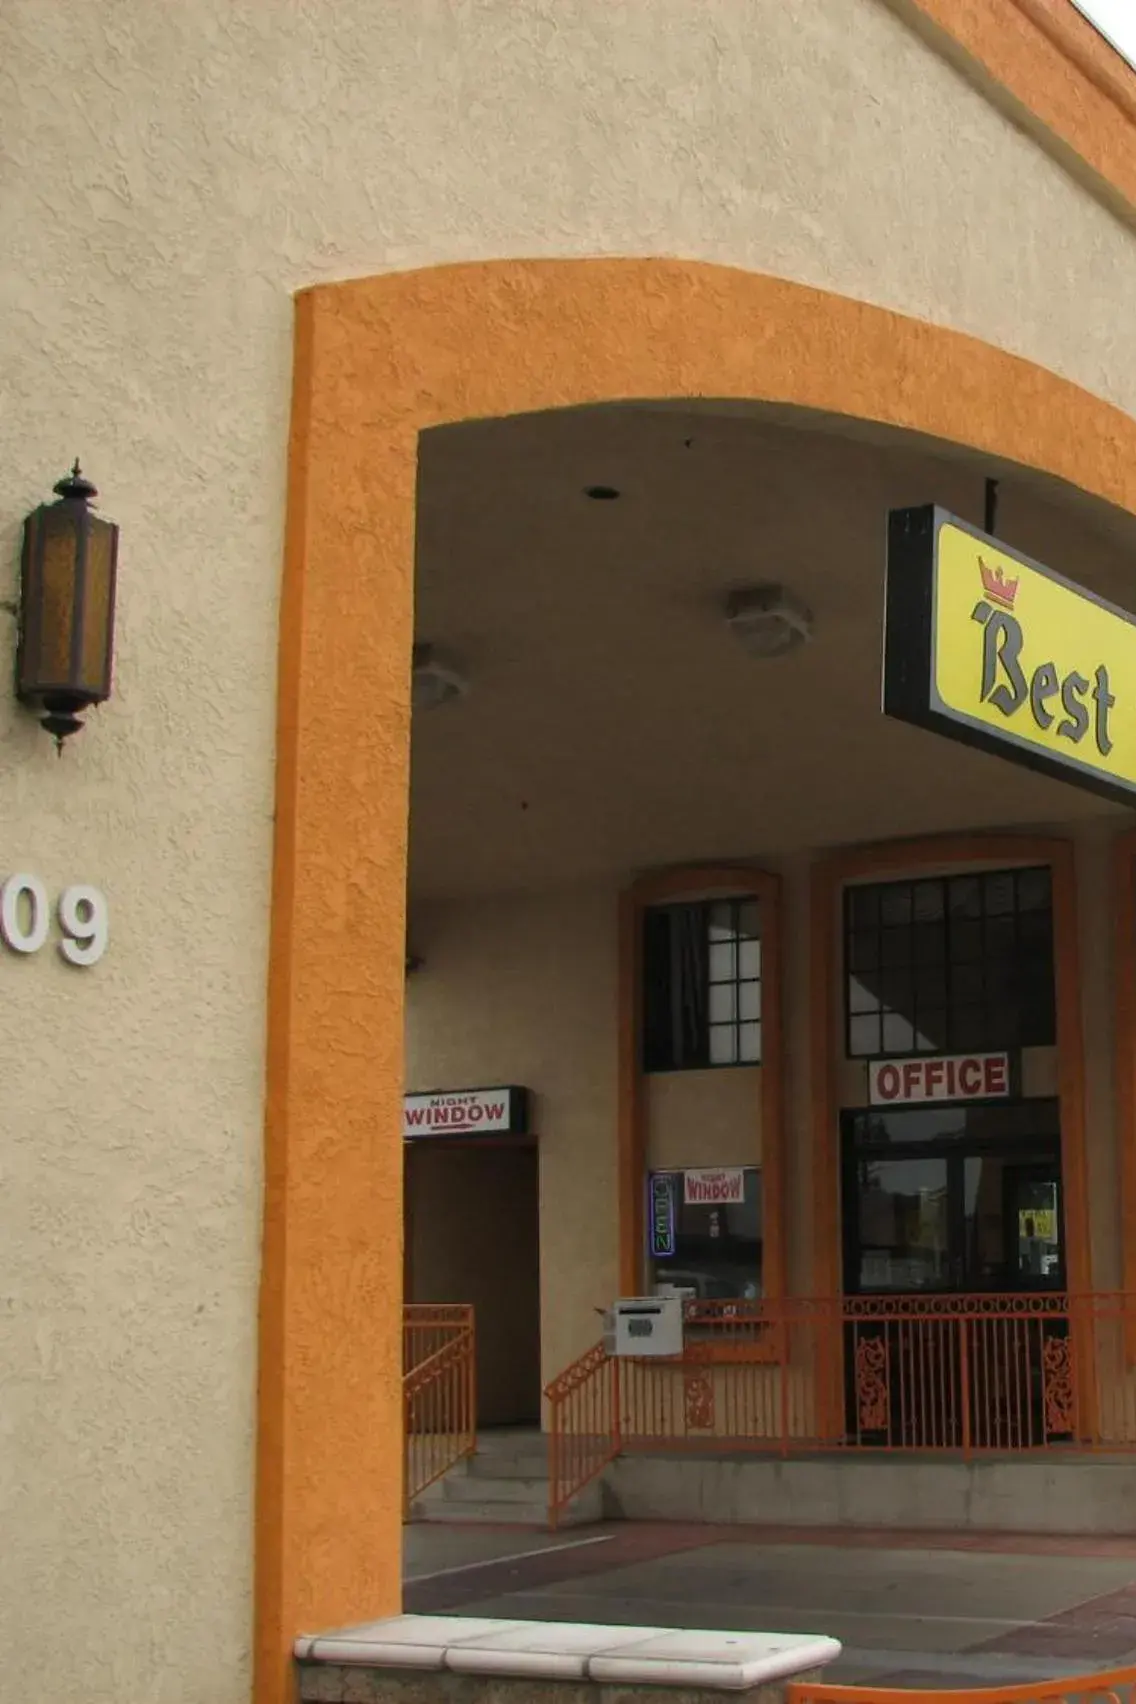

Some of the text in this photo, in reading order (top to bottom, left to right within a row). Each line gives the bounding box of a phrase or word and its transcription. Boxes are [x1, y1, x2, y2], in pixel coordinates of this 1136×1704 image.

[971, 600, 1116, 757] Best
[1, 873, 108, 966] 09
[877, 1056, 1006, 1100] OFFICE
[404, 1102, 505, 1126] WINDOW
[430, 1096, 477, 1107] NIGHT
[687, 1174, 742, 1201] WINDOW
